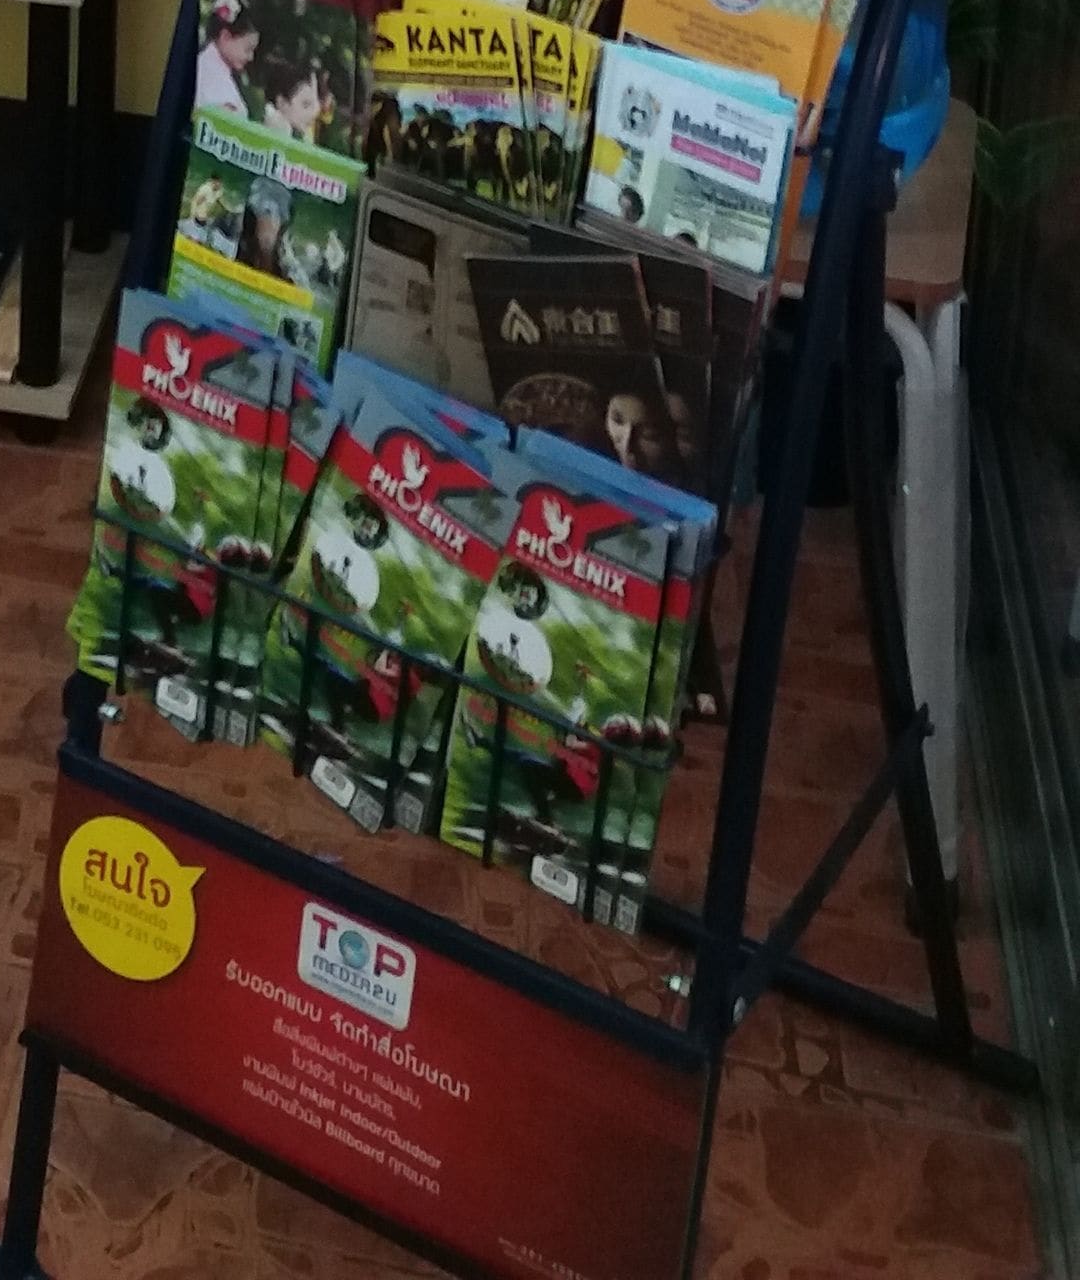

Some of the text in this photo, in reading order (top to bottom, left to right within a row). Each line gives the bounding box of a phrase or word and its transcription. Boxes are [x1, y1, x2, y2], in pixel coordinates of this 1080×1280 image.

[406, 24, 508, 58] KANTA
[142, 363, 239, 426] PHOENIX
[369, 463, 469, 555] PHOENIX
[516, 528, 627, 598] PHOENIX
[83, 847, 172, 909] สนใจ
[225, 957, 322, 1024] รับออกแบบ
[329, 1010, 471, 1103] จัดทำสื่อโฆษณา
